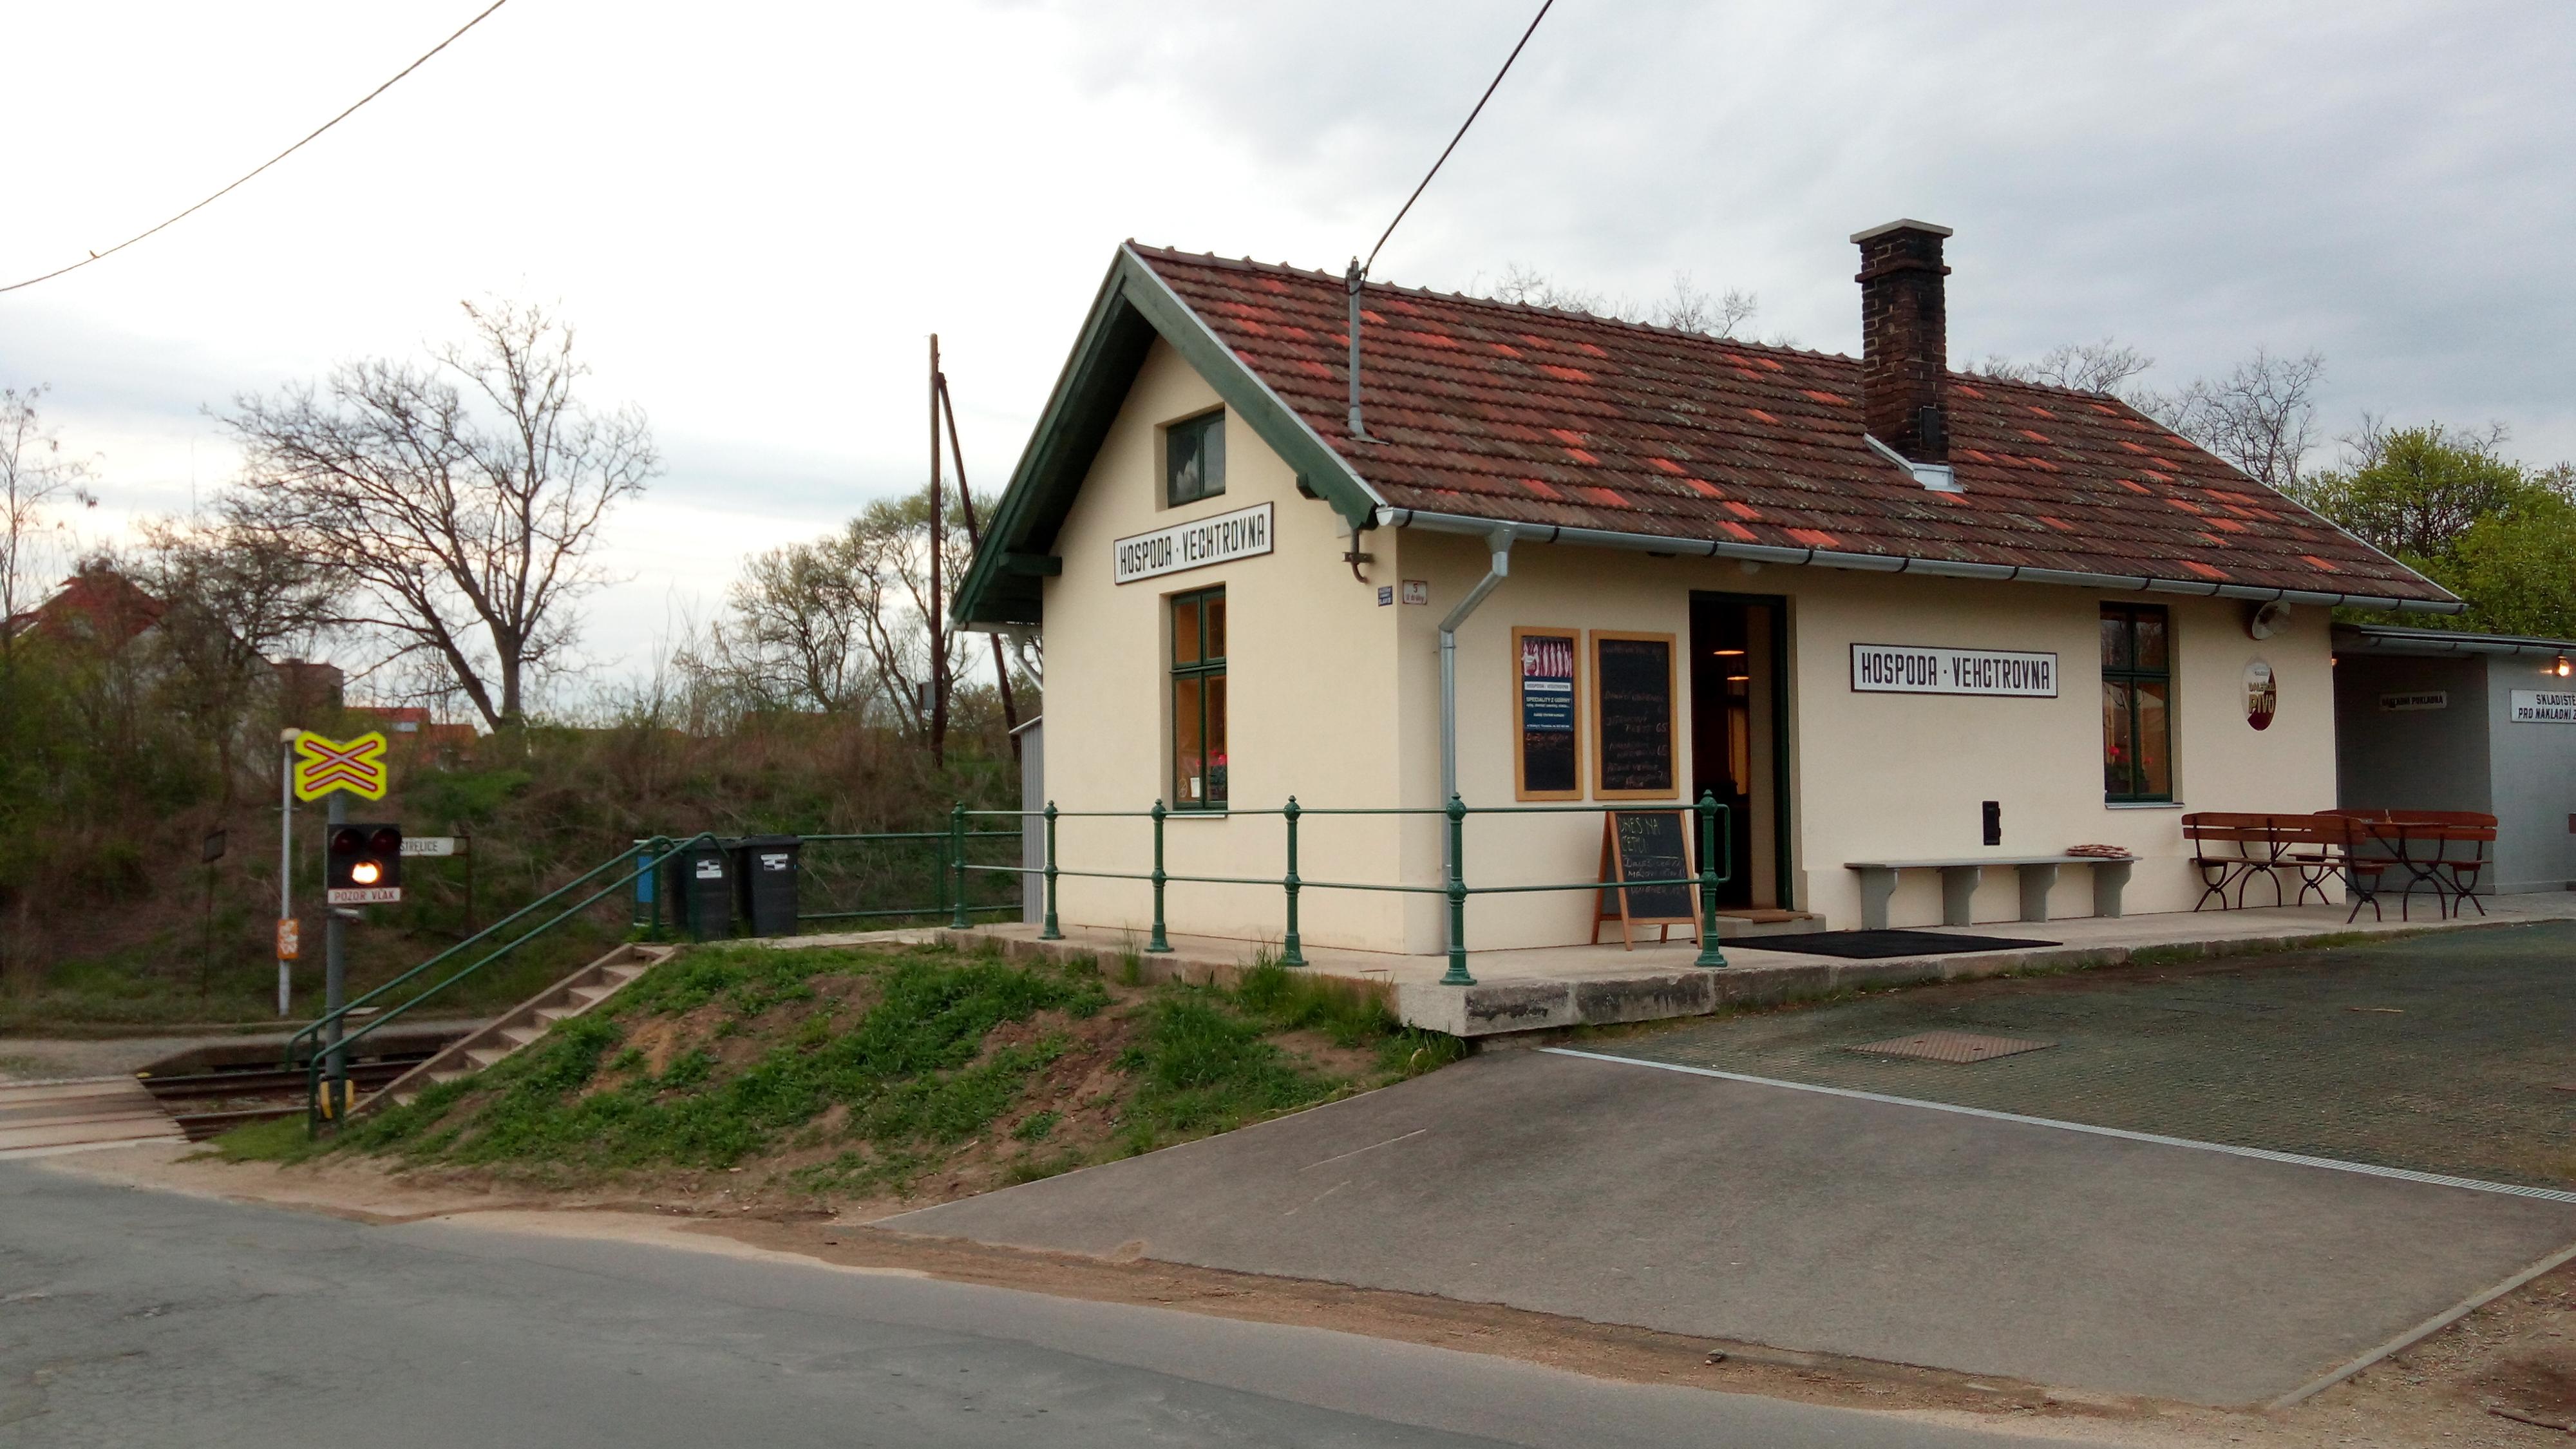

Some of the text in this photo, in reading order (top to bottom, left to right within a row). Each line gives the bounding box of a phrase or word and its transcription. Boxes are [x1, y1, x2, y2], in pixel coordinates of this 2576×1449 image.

[1120, 513, 1265, 576] HOSPODA VECHTROVNA
[1861, 652, 2050, 690] HOSPODA VEHCTROVNA
[2248, 694, 2275, 714] PIVO
[2518, 707, 2533, 719] PRO
[335, 889, 395, 901] POZOR VLAK
